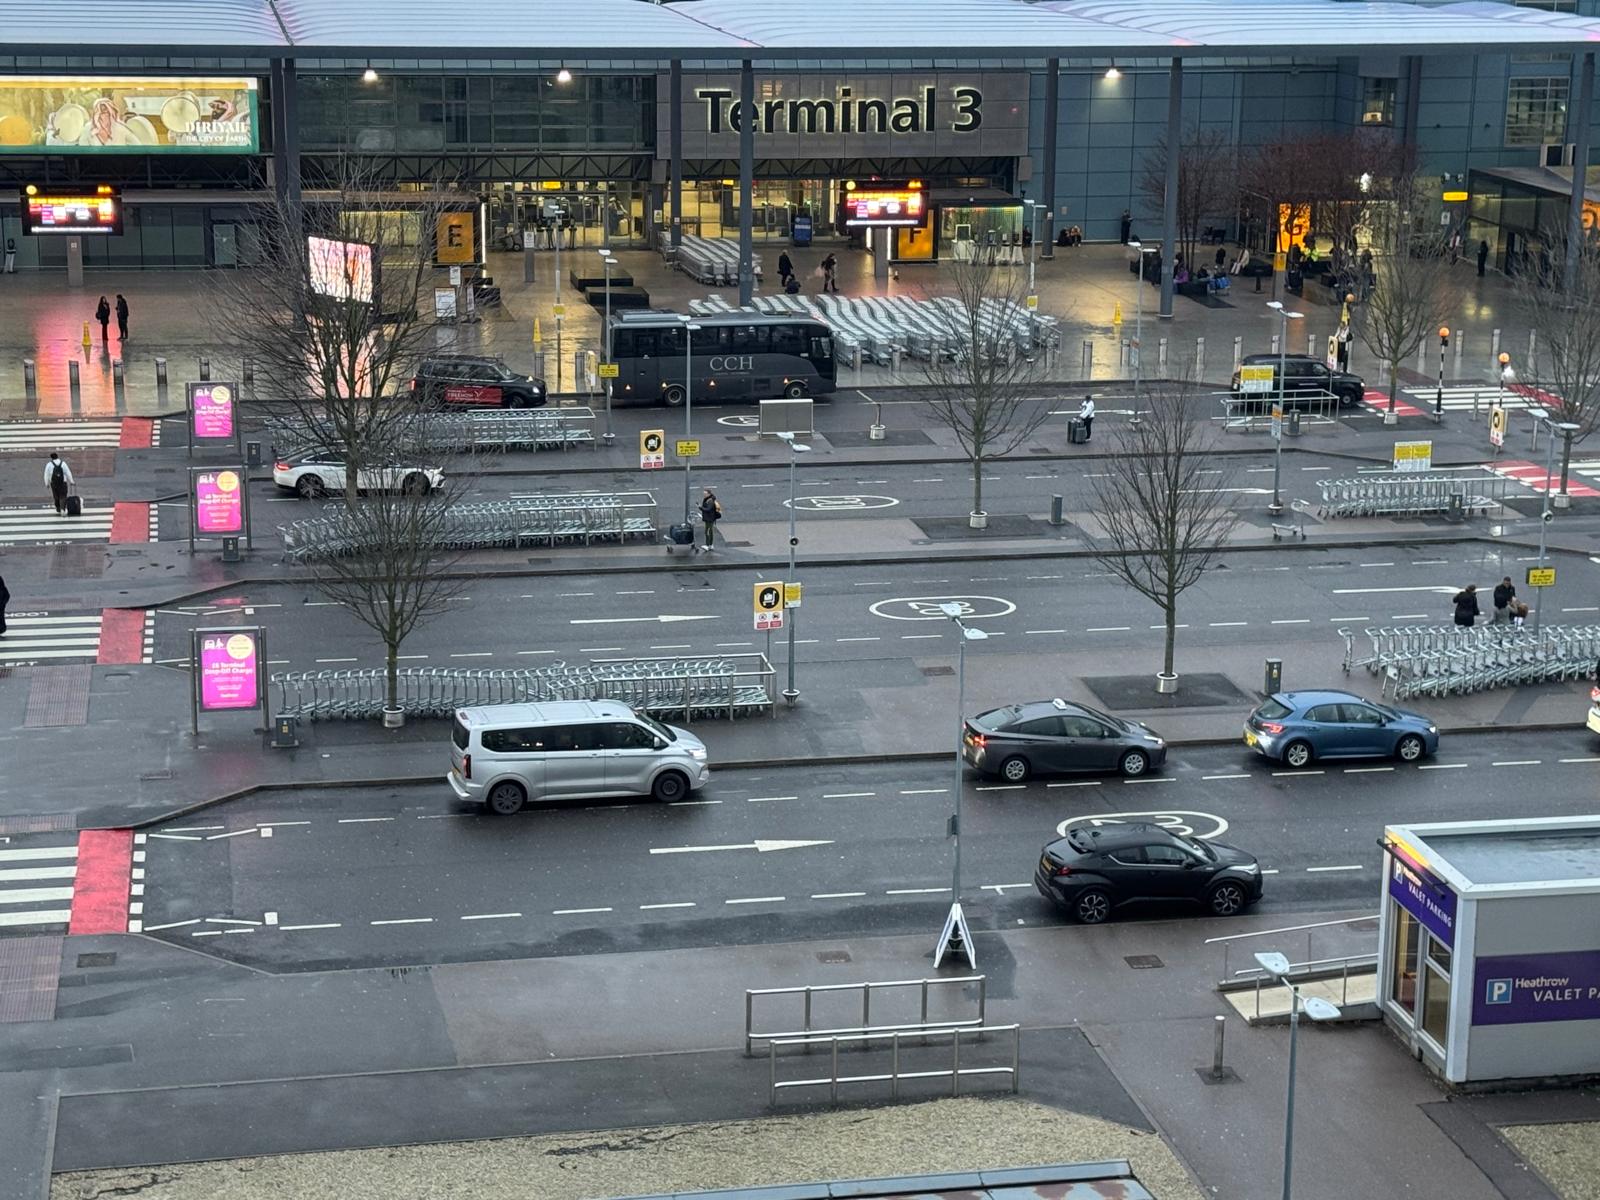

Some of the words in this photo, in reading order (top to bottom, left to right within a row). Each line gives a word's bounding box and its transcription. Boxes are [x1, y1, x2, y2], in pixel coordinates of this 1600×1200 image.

[697, 87, 937, 134] Terminal
[952, 87, 983, 133] 3
[448, 224, 463, 247] E
[709, 356, 754, 371] CCH
[1408, 882, 1427, 902] VALET
[1426, 898, 1452, 928] PARKING
[1492, 982, 1507, 1001] P
[1515, 976, 1569, 988] Heathrow
[1533, 988, 1582, 1002] VALET
